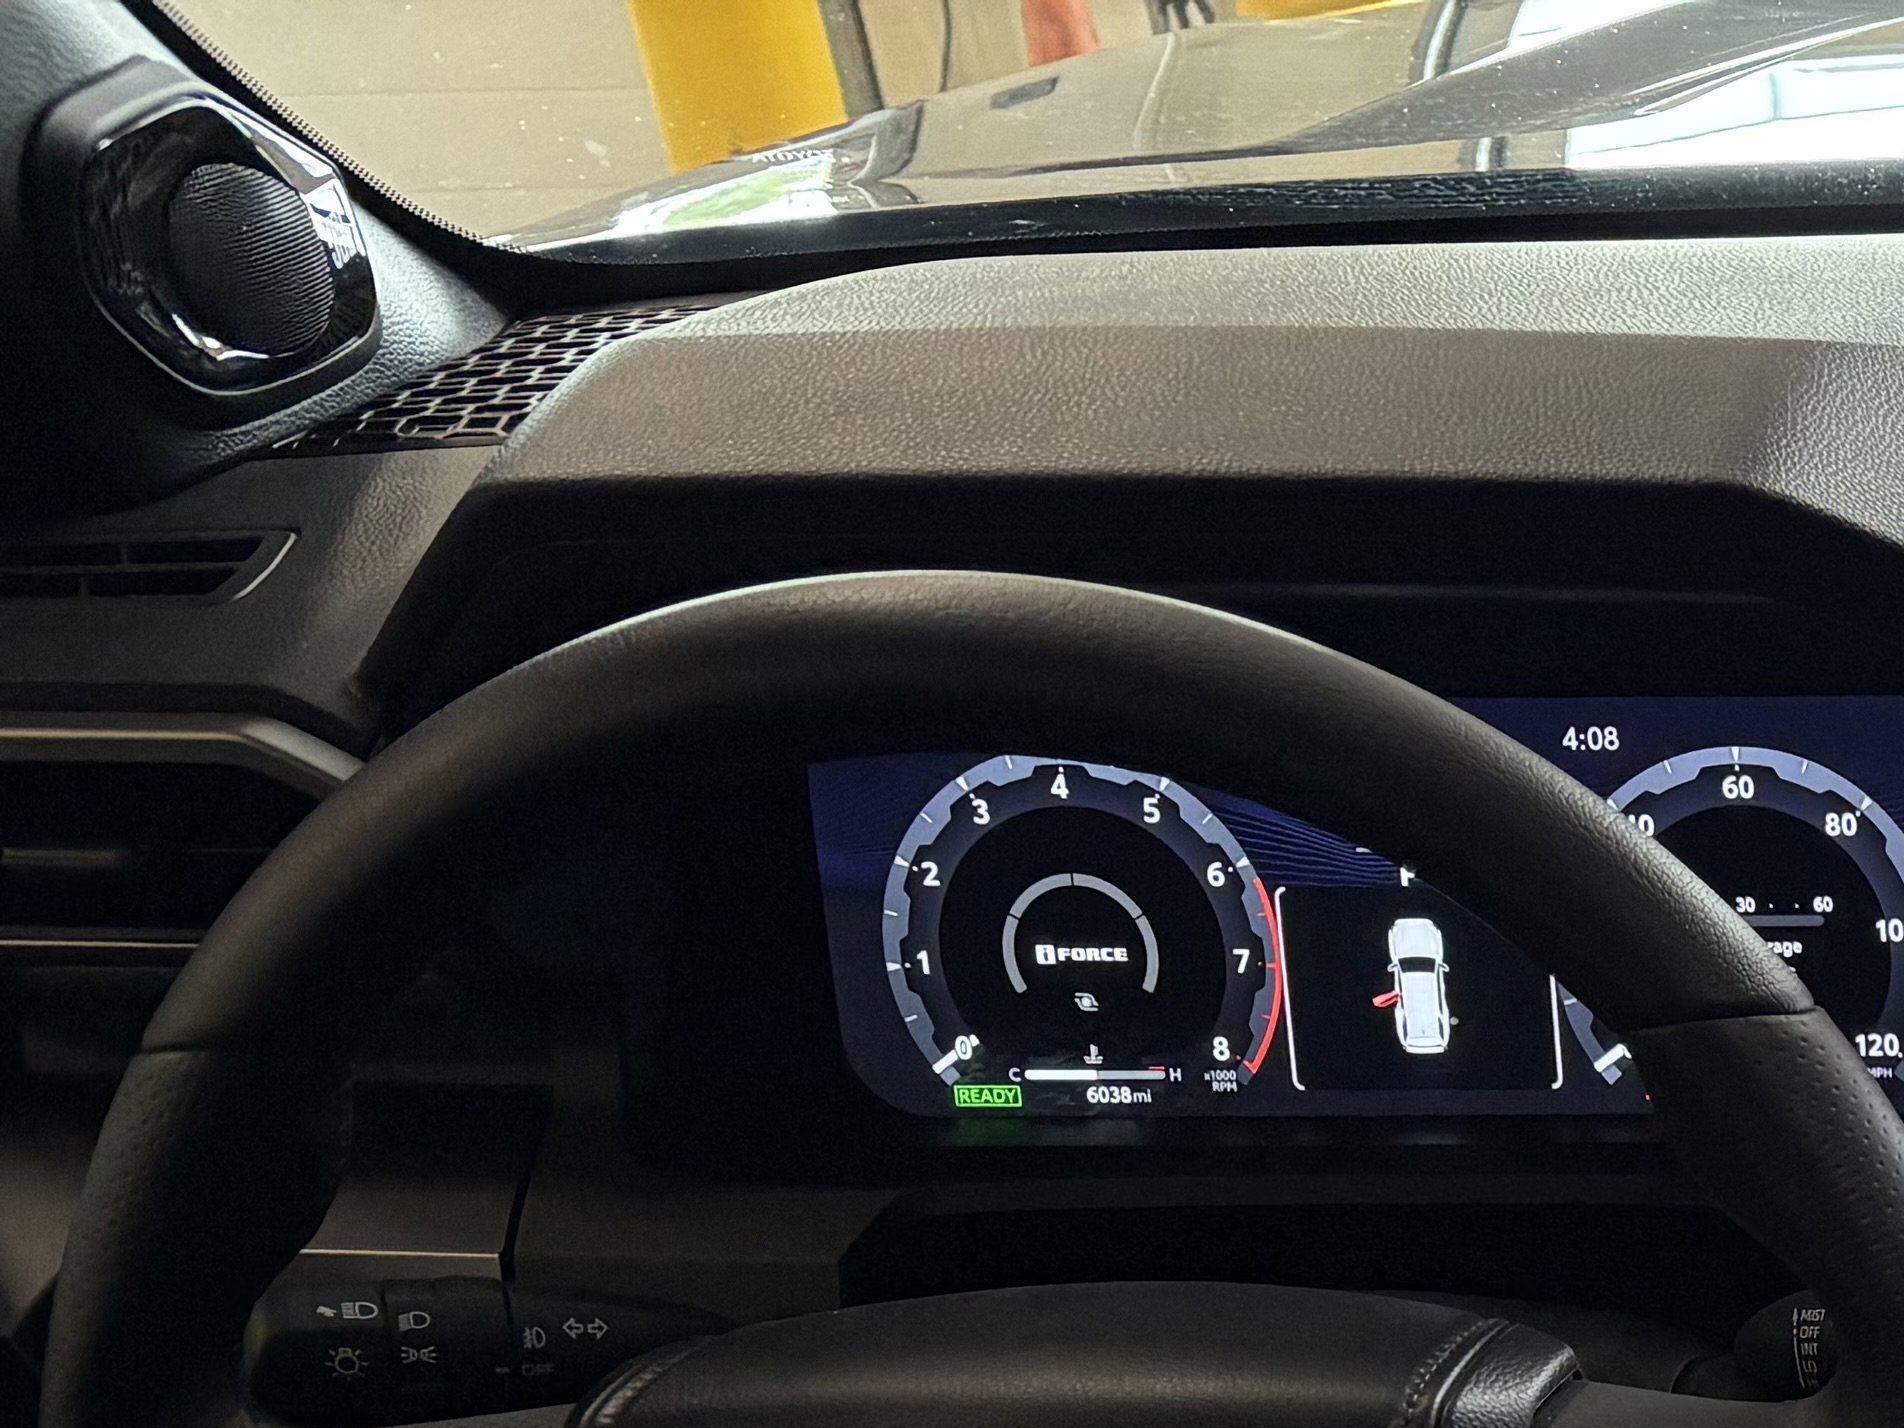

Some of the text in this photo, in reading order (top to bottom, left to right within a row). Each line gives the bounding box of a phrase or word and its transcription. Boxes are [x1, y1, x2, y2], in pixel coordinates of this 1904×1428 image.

[1562, 726, 1620, 752] 4:08
[1050, 774, 1070, 799] 4
[1721, 776, 1754, 799] 60
[972, 798, 991, 825] 3
[1143, 799, 1161, 823] 5
[1824, 812, 1857, 837] 80
[920, 861, 941, 887] 2
[1206, 862, 1226, 887] 6
[1735, 895, 1834, 913] 30 60
[916, 949, 930, 976] 1
[1232, 948, 1251, 975] 7
[954, 1034, 973, 1060] 0
[1212, 1035, 1231, 1062] 8
[1854, 1032, 1900, 1057] 120
[1008, 1067, 1182, 1083] C H
[1211, 1081, 1238, 1093] RPM
[958, 1087, 1019, 1105] READY
[1800, 1326, 1820, 1339] OFF
